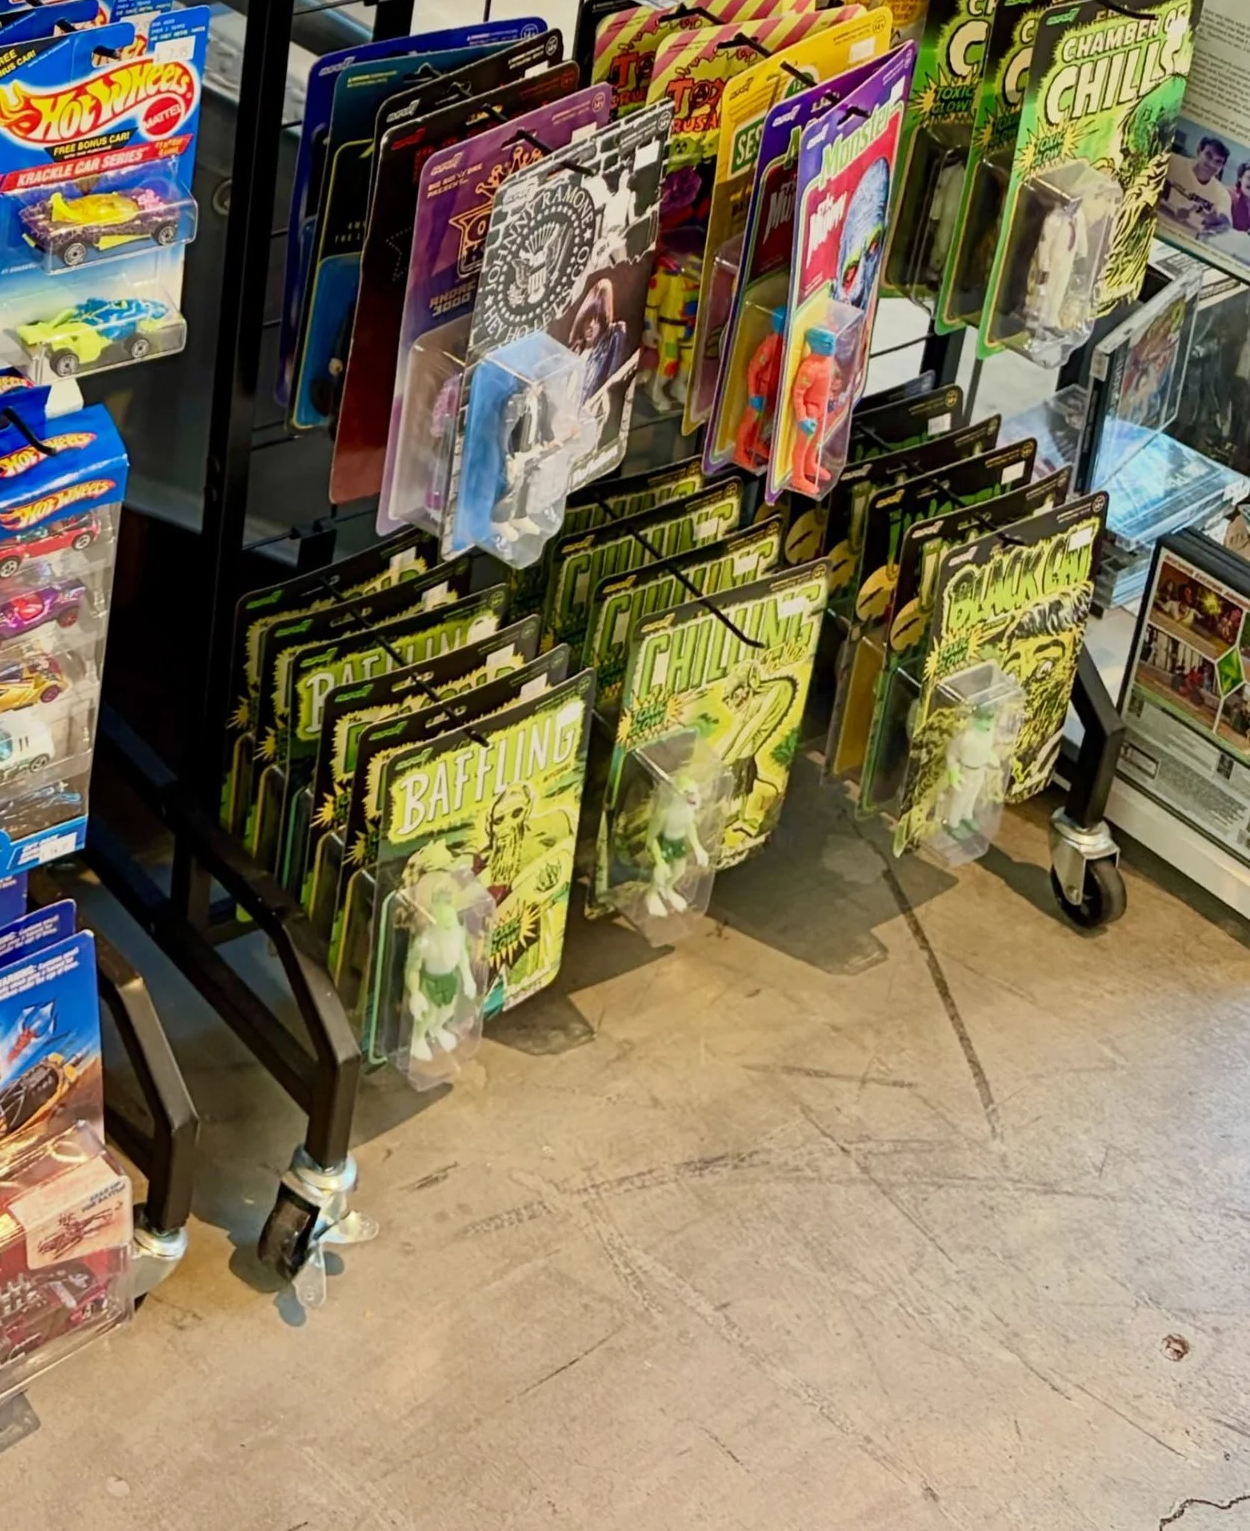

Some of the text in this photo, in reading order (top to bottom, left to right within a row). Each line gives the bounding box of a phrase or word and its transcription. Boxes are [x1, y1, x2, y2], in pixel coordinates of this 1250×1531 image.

[1062, 18, 1158, 62] CHAMBER
[1046, 37, 1185, 126] CHILLS
[143, 104, 184, 129] MATTEL
[53, 131, 131, 157] FREE BONUS CAR!
[17, 150, 143, 186] KRACKLE CAR SERIES
[541, 185, 597, 231] RAMONE
[395, 718, 576, 837] BAFFLING
